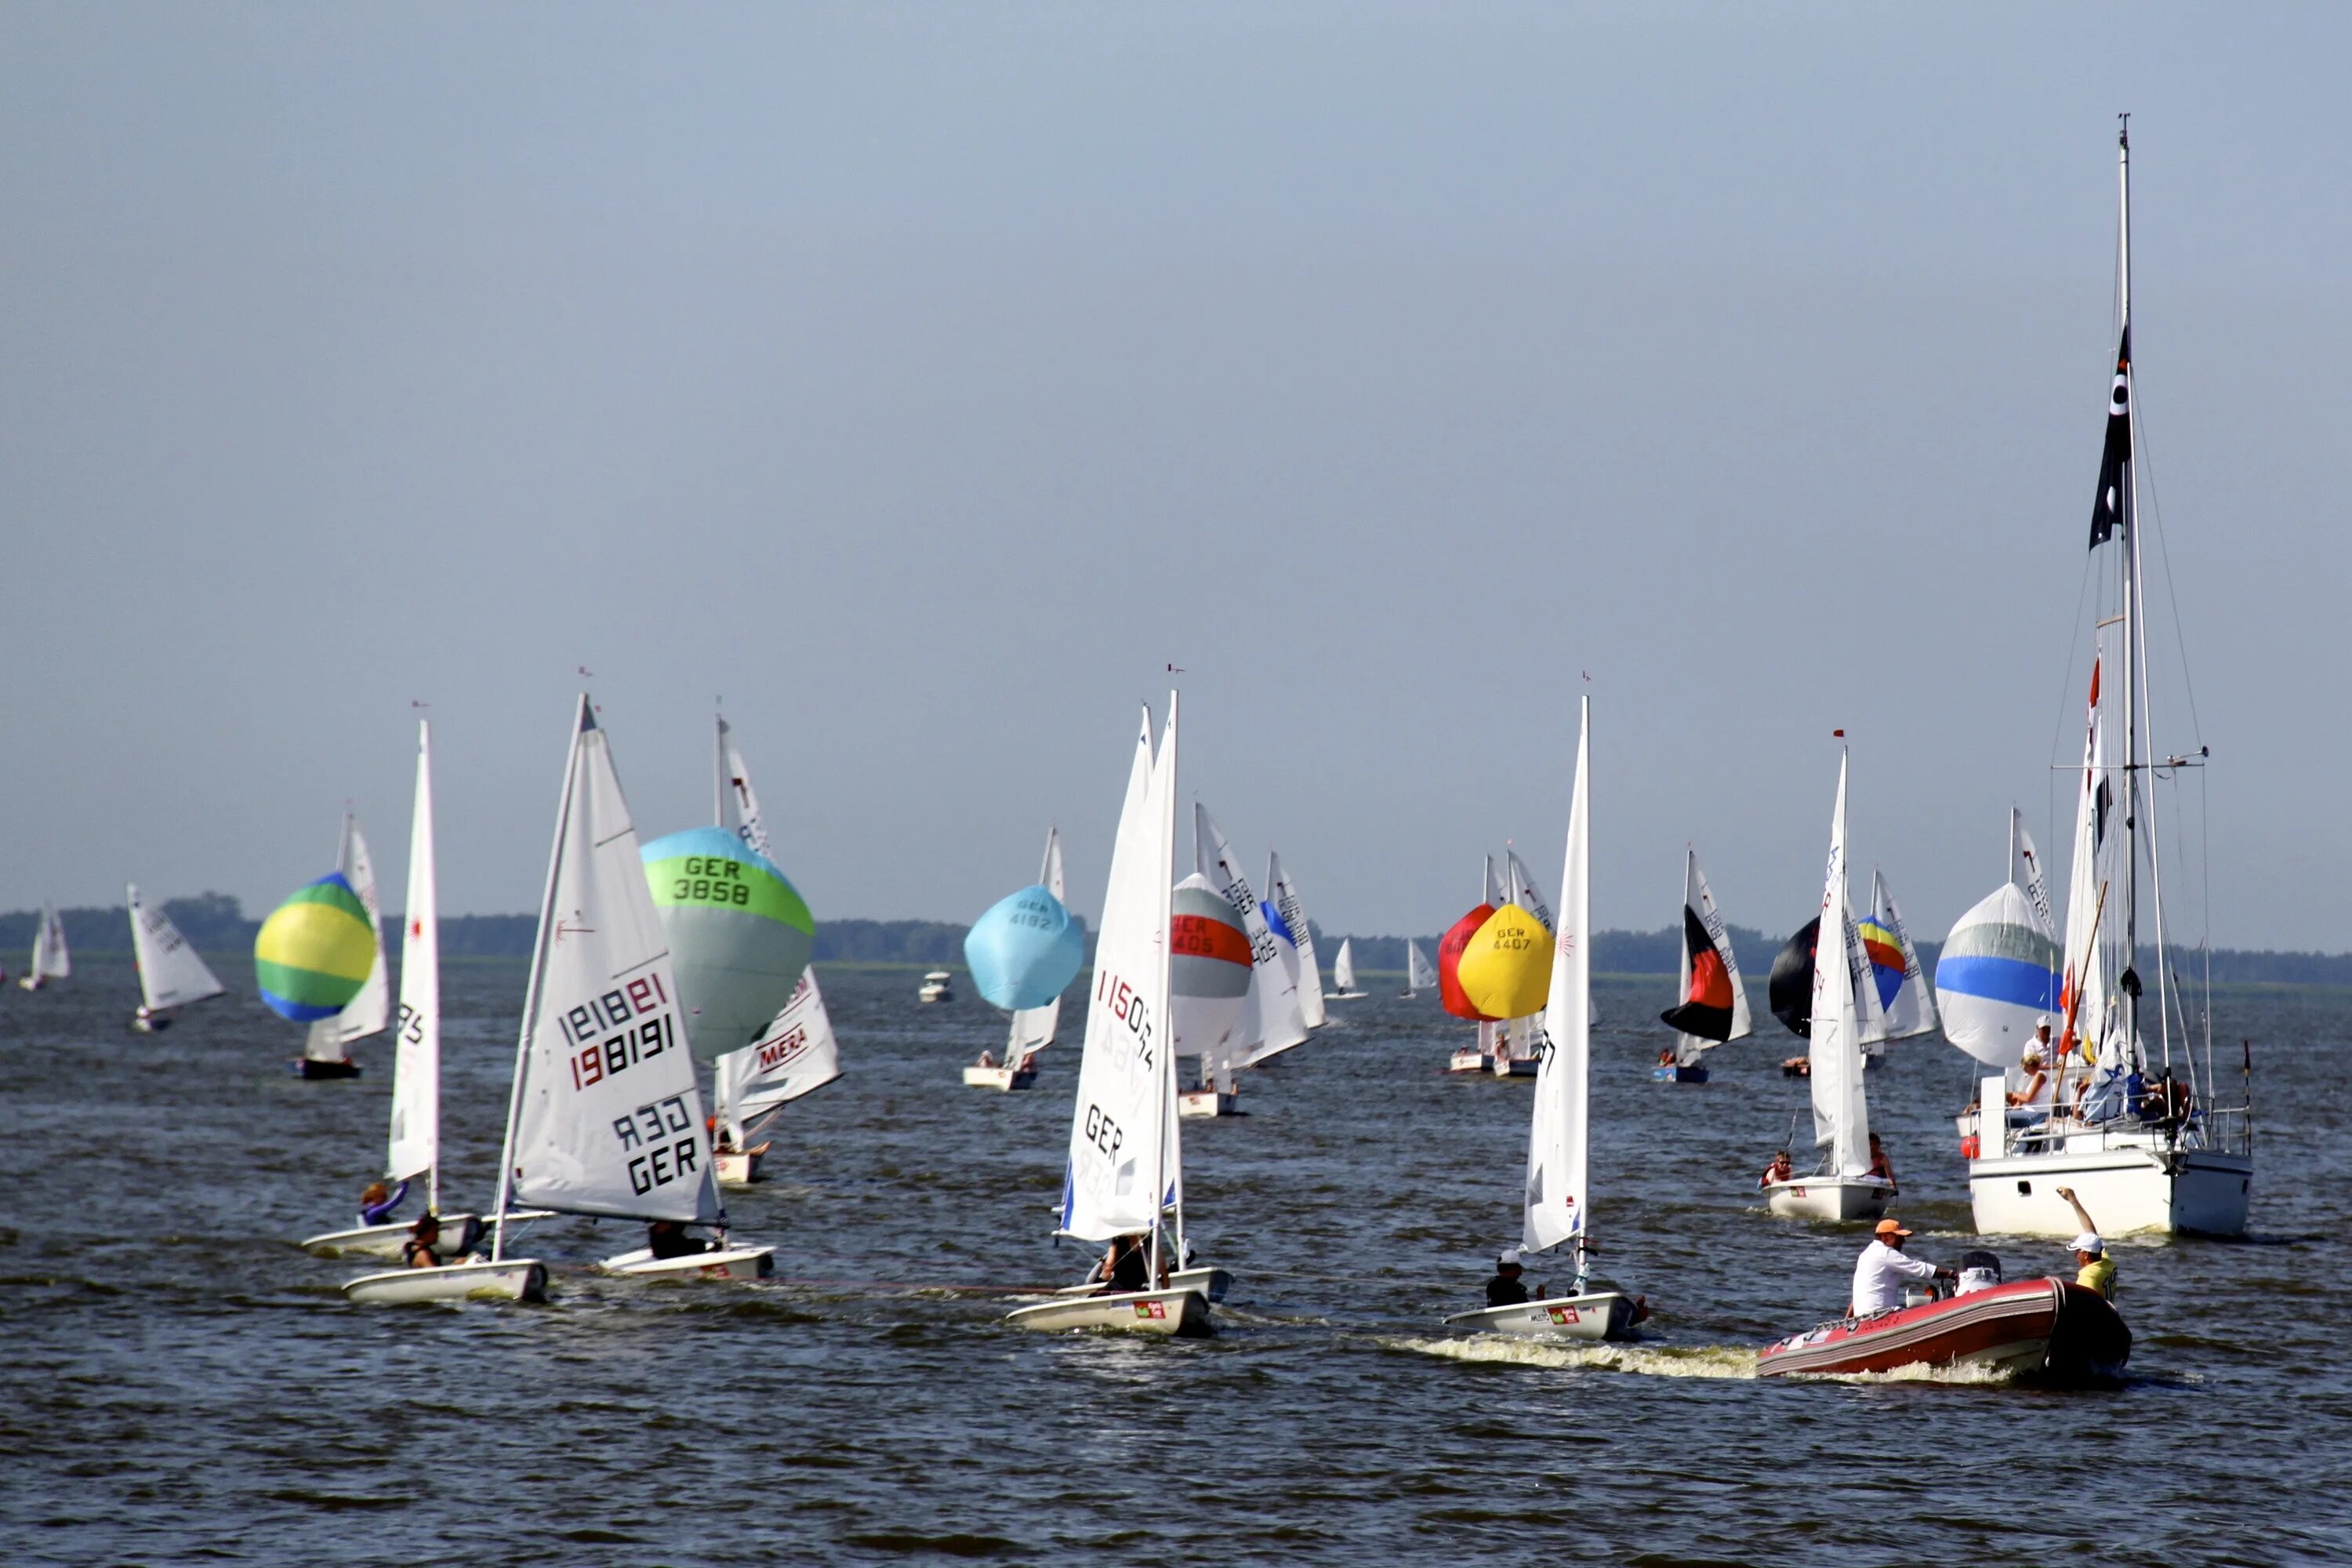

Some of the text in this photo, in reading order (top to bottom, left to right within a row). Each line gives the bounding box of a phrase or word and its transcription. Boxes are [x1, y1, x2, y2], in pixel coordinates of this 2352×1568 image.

[685, 857, 740, 880] GER
[673, 879, 750, 906] 3858
[1018, 899, 1049, 913] GER
[1494, 938, 1530, 951] 4407
[1497, 927, 1525, 938] GER
[570, 1013, 675, 1092] 198191
[759, 1028, 808, 1069] MERA
[1085, 1102, 1123, 1167] GER
[627, 1137, 698, 1196] GER
